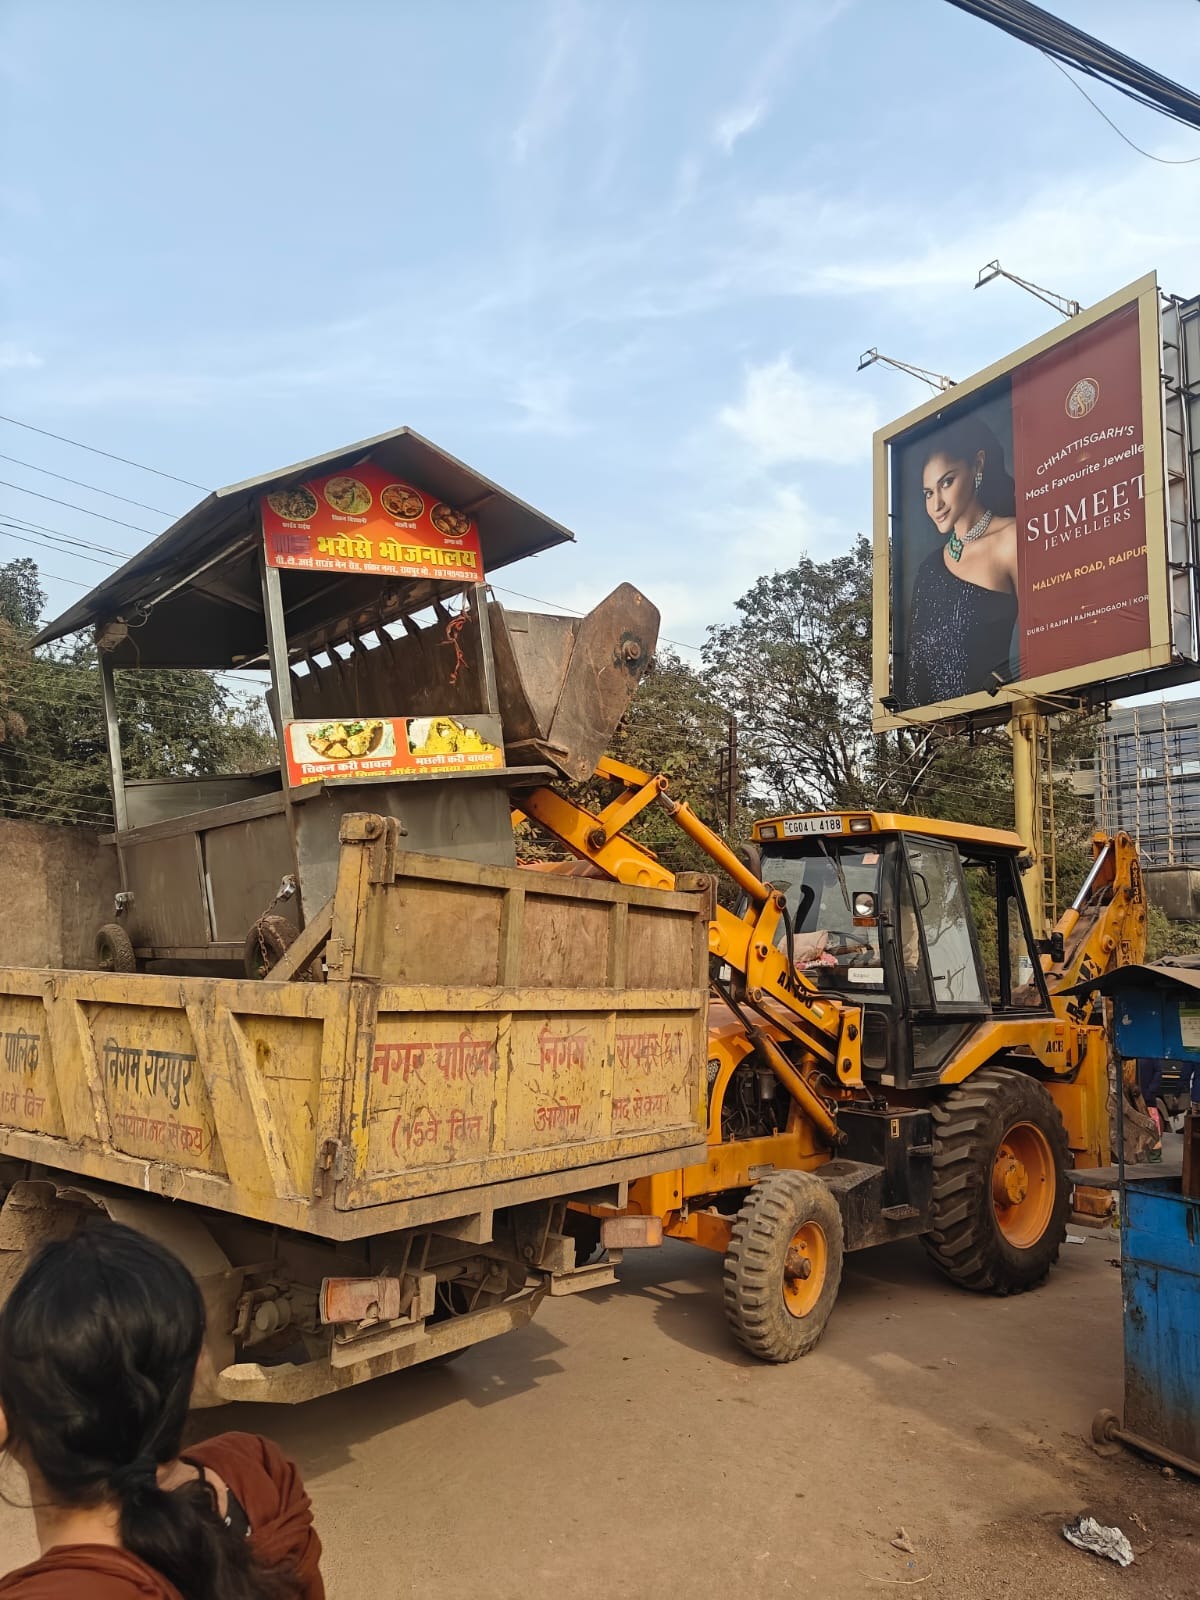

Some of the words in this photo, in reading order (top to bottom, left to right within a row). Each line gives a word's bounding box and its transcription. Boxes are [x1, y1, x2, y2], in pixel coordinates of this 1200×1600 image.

[1036, 425, 1135, 475] CHHATTISGARH'S
[1025, 484, 1050, 501] Most
[1051, 462, 1100, 490] Favourite
[1026, 473, 1146, 542] SUMEET
[1044, 508, 1132, 551] JEWELLERS
[316, 531, 374, 560] भरोसे
[379, 536, 478, 569] भोजनालय
[1032, 571, 1073, 592] MALVIYA
[1074, 560, 1107, 578] ROAD,
[1108, 544, 1150, 567] RAIPUR
[1026, 625, 1046, 637] DURG
[1049, 617, 1070, 630] RAJIM
[1074, 600, 1128, 622] RAJNANDGAON
[302, 763, 335, 774] चिकन
[337, 761, 359, 770] करी
[361, 760, 392, 769] चावल
[415, 755, 445, 765] मछली
[447, 754, 465, 763] करी
[467, 753, 493, 762] चावल
[788, 822, 809, 833] CG04
[811, 820, 817, 831] L
[372, 1041, 433, 1086] नगर
[538, 1027, 587, 1073] निगम
[1046, 1040, 1064, 1053] ACE
[5, 1026, 41, 1073] पालिक
[103, 1036, 144, 1097] निगम
[144, 1049, 197, 1110] रायपुर
